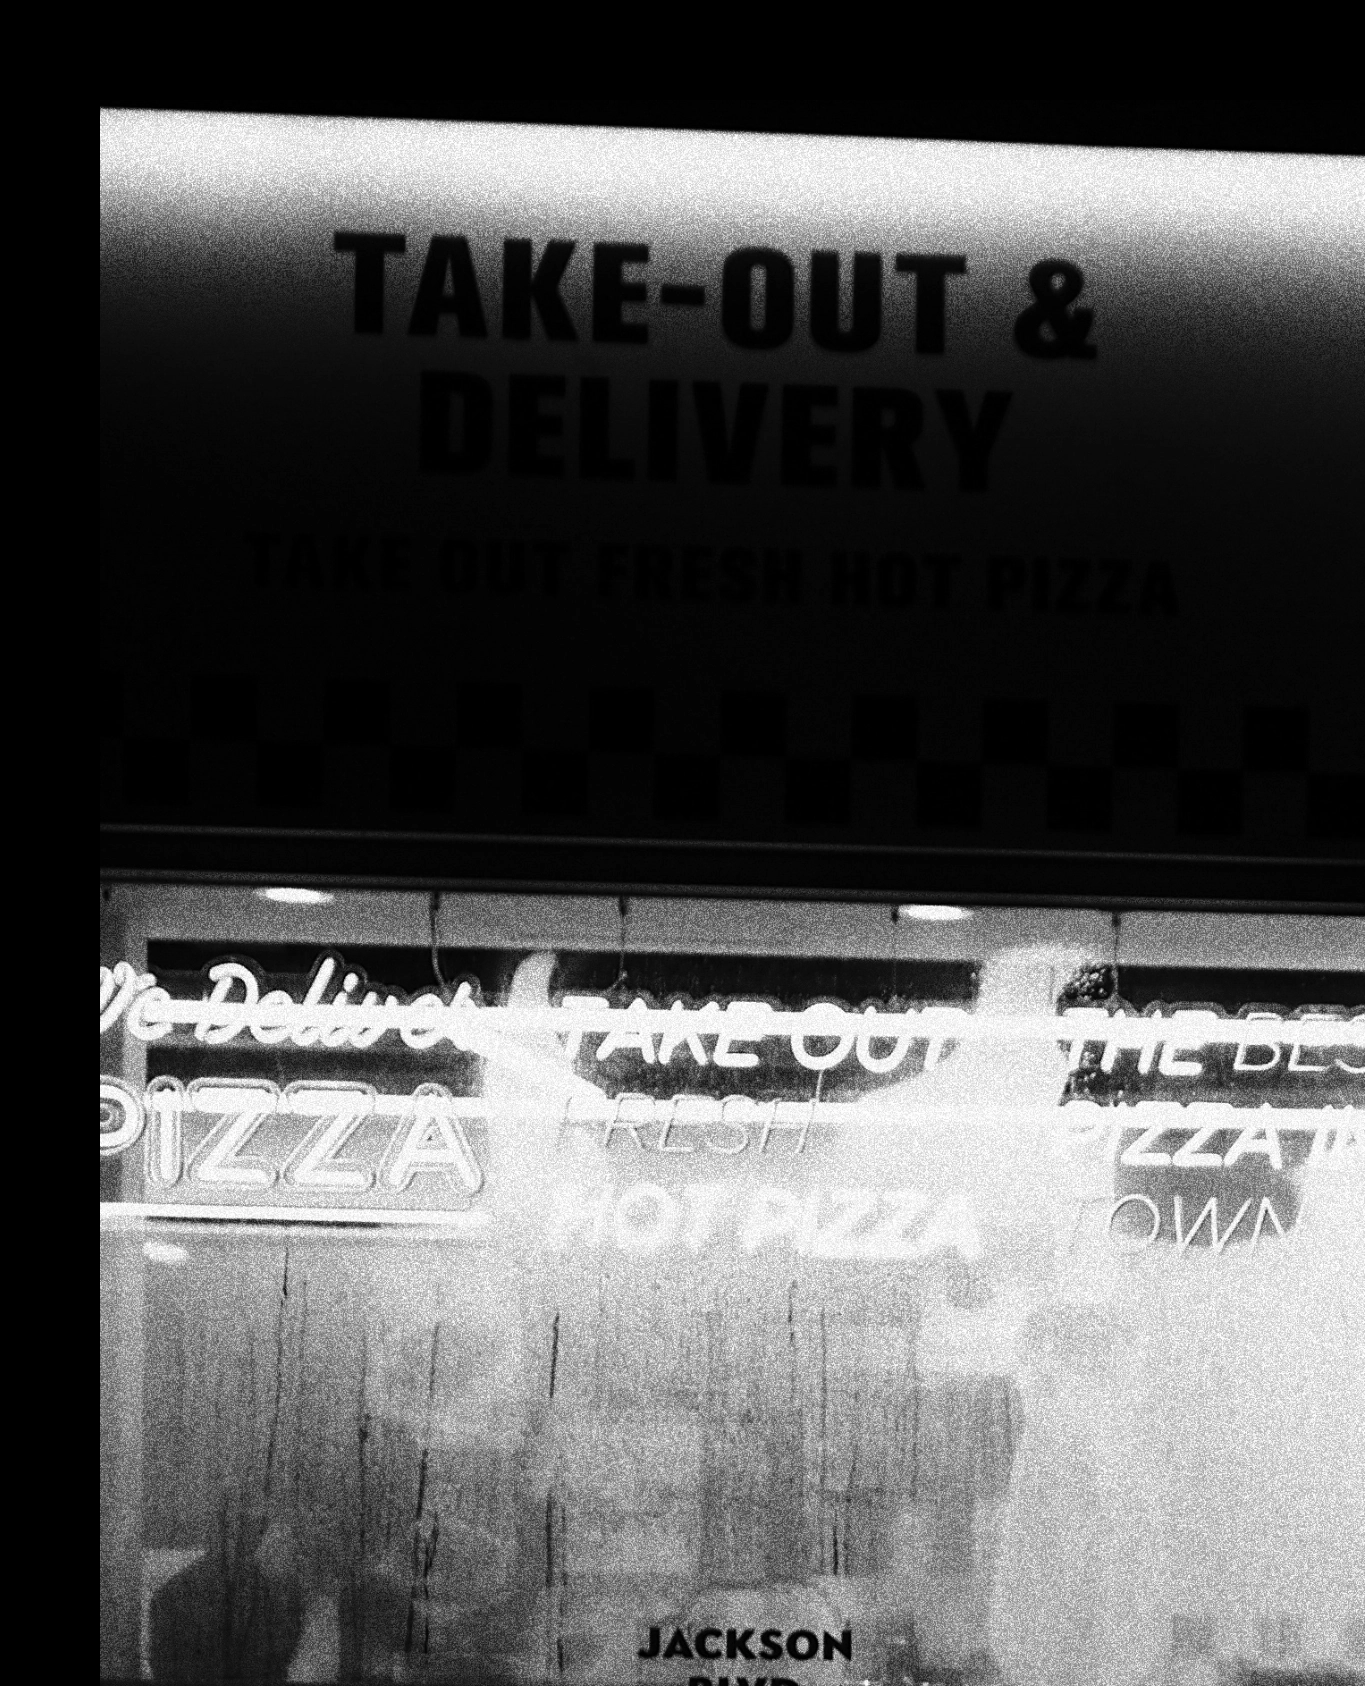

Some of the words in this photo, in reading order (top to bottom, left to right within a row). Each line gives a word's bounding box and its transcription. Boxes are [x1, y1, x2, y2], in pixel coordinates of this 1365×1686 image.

[333, 232, 967, 354] TAKE-OUT
[1014, 259, 1099, 359] &
[420, 371, 1013, 491] DELIVERY
[245, 531, 411, 593] TAKE
[439, 539, 568, 597] OUT
[600, 545, 801, 603] FRESH
[831, 549, 962, 609] HOT
[988, 556, 1180, 617] PIZZA
[562, 996, 775, 1065] TAKE
[791, 1003, 975, 1073] OUT
[1062, 1009, 1218, 1075] THE
[547, 1180, 737, 1257] HOT
[738, 1184, 985, 1263] PIZZA
[637, 1626, 853, 1662] JACKSON
